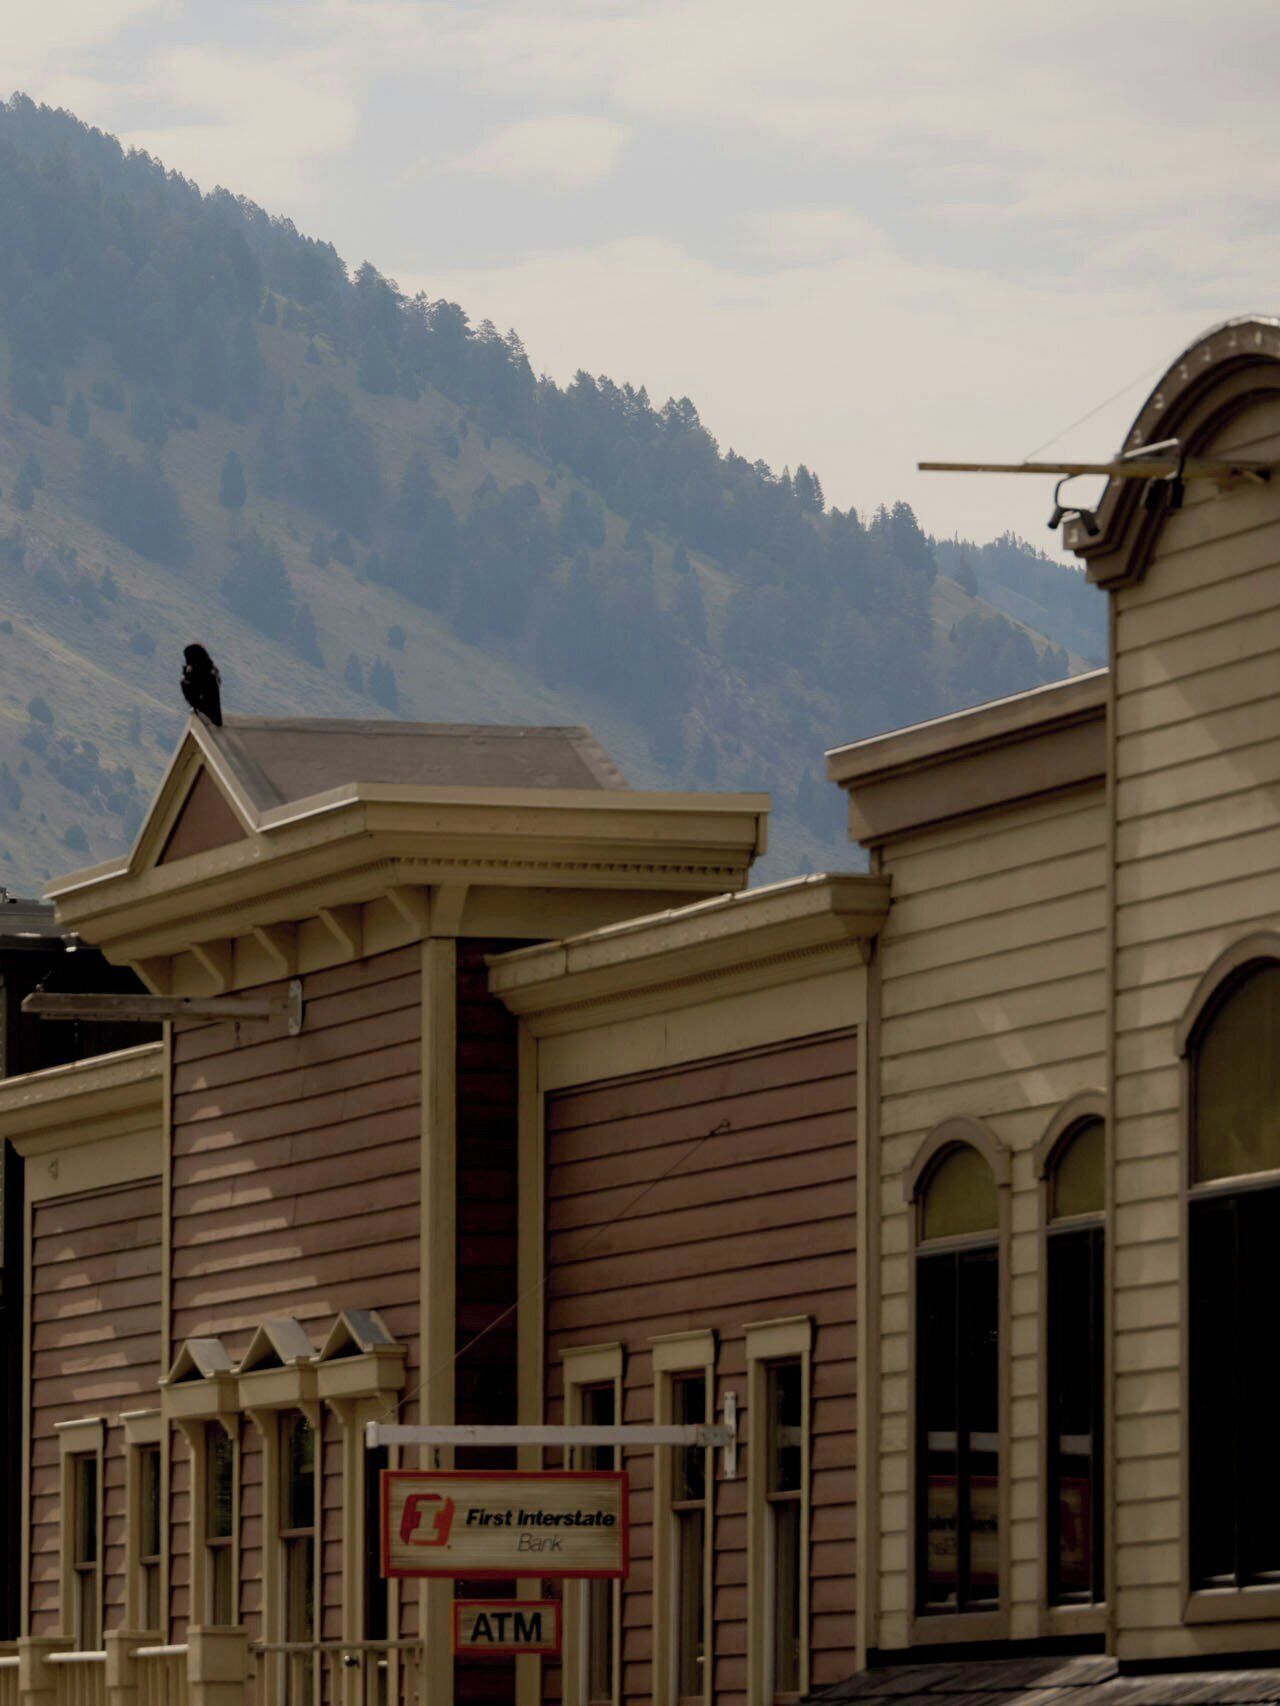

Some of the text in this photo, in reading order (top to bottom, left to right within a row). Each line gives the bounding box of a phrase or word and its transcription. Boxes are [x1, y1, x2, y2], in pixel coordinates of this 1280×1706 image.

[466, 1508, 616, 1527] First Interstate
[517, 1532, 562, 1552] Bank
[470, 1612, 542, 1642] ATM
